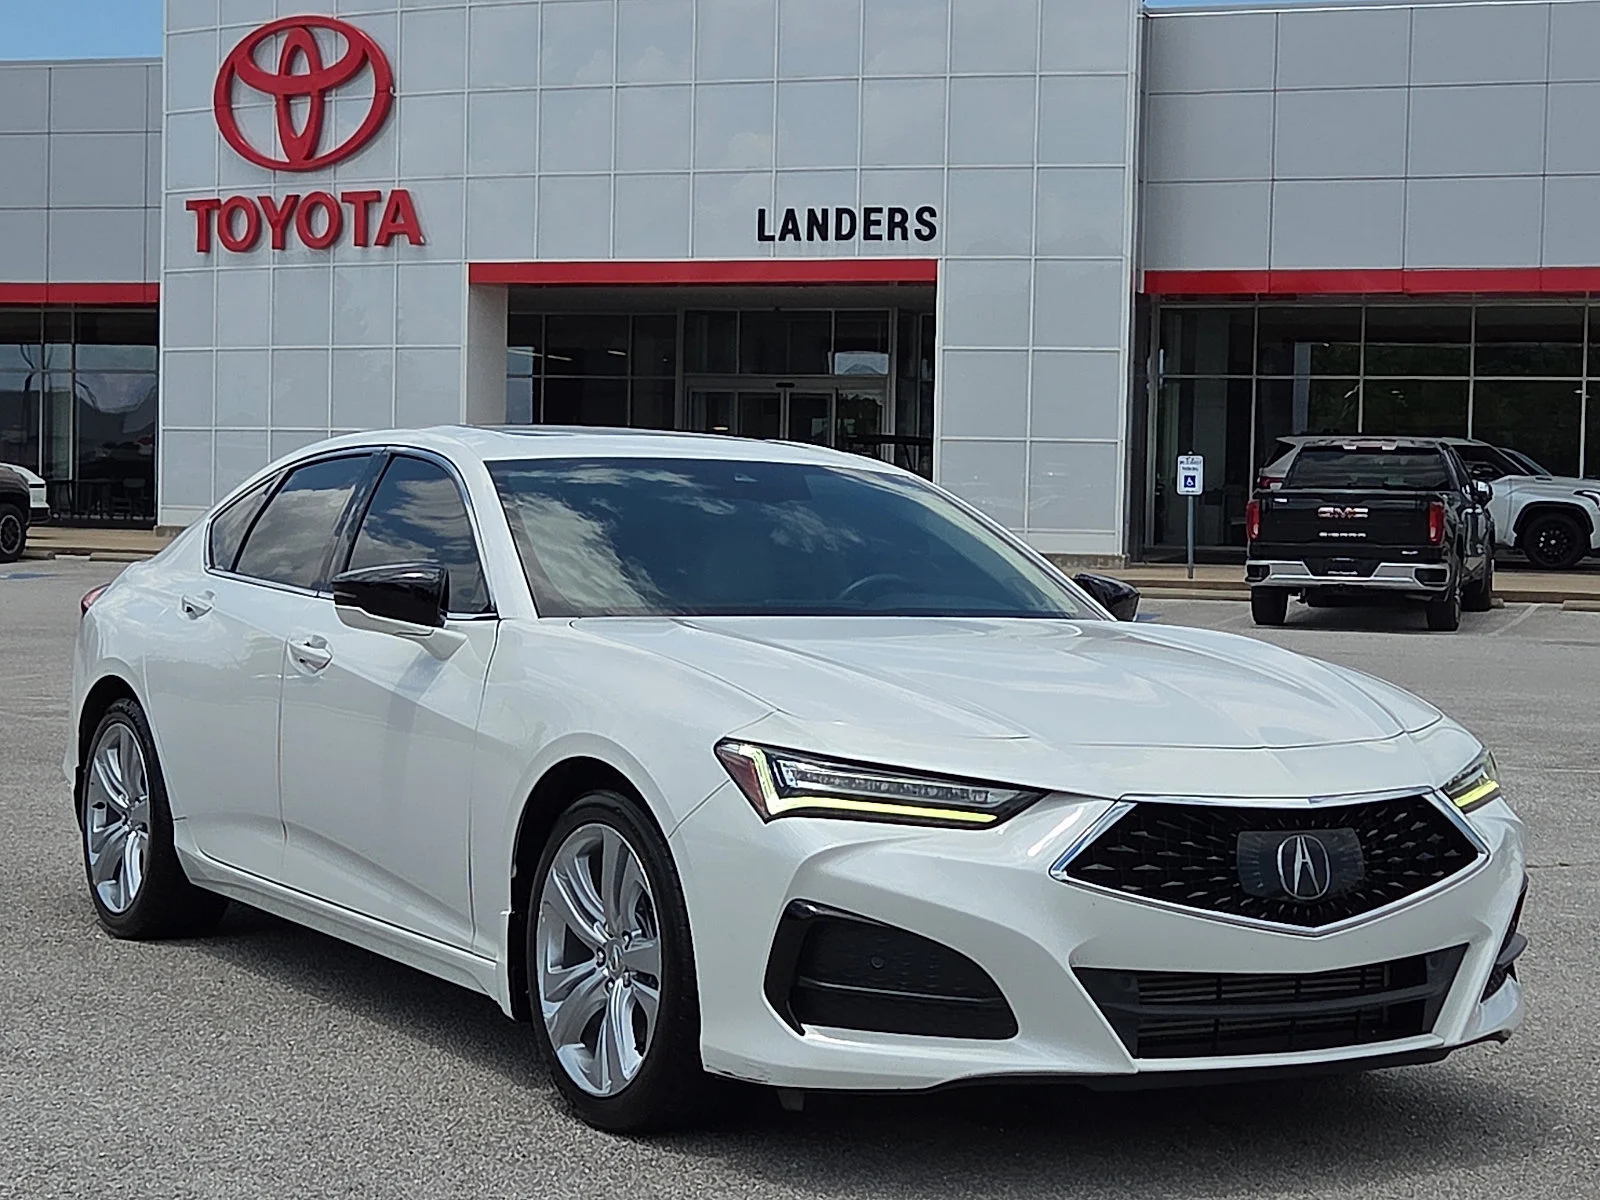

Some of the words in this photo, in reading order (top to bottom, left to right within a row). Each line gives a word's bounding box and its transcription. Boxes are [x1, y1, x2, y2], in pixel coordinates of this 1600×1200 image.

[185, 189, 426, 253] TOYOTA
[757, 205, 937, 242] LANDERS
[1318, 507, 1369, 518] GMC
